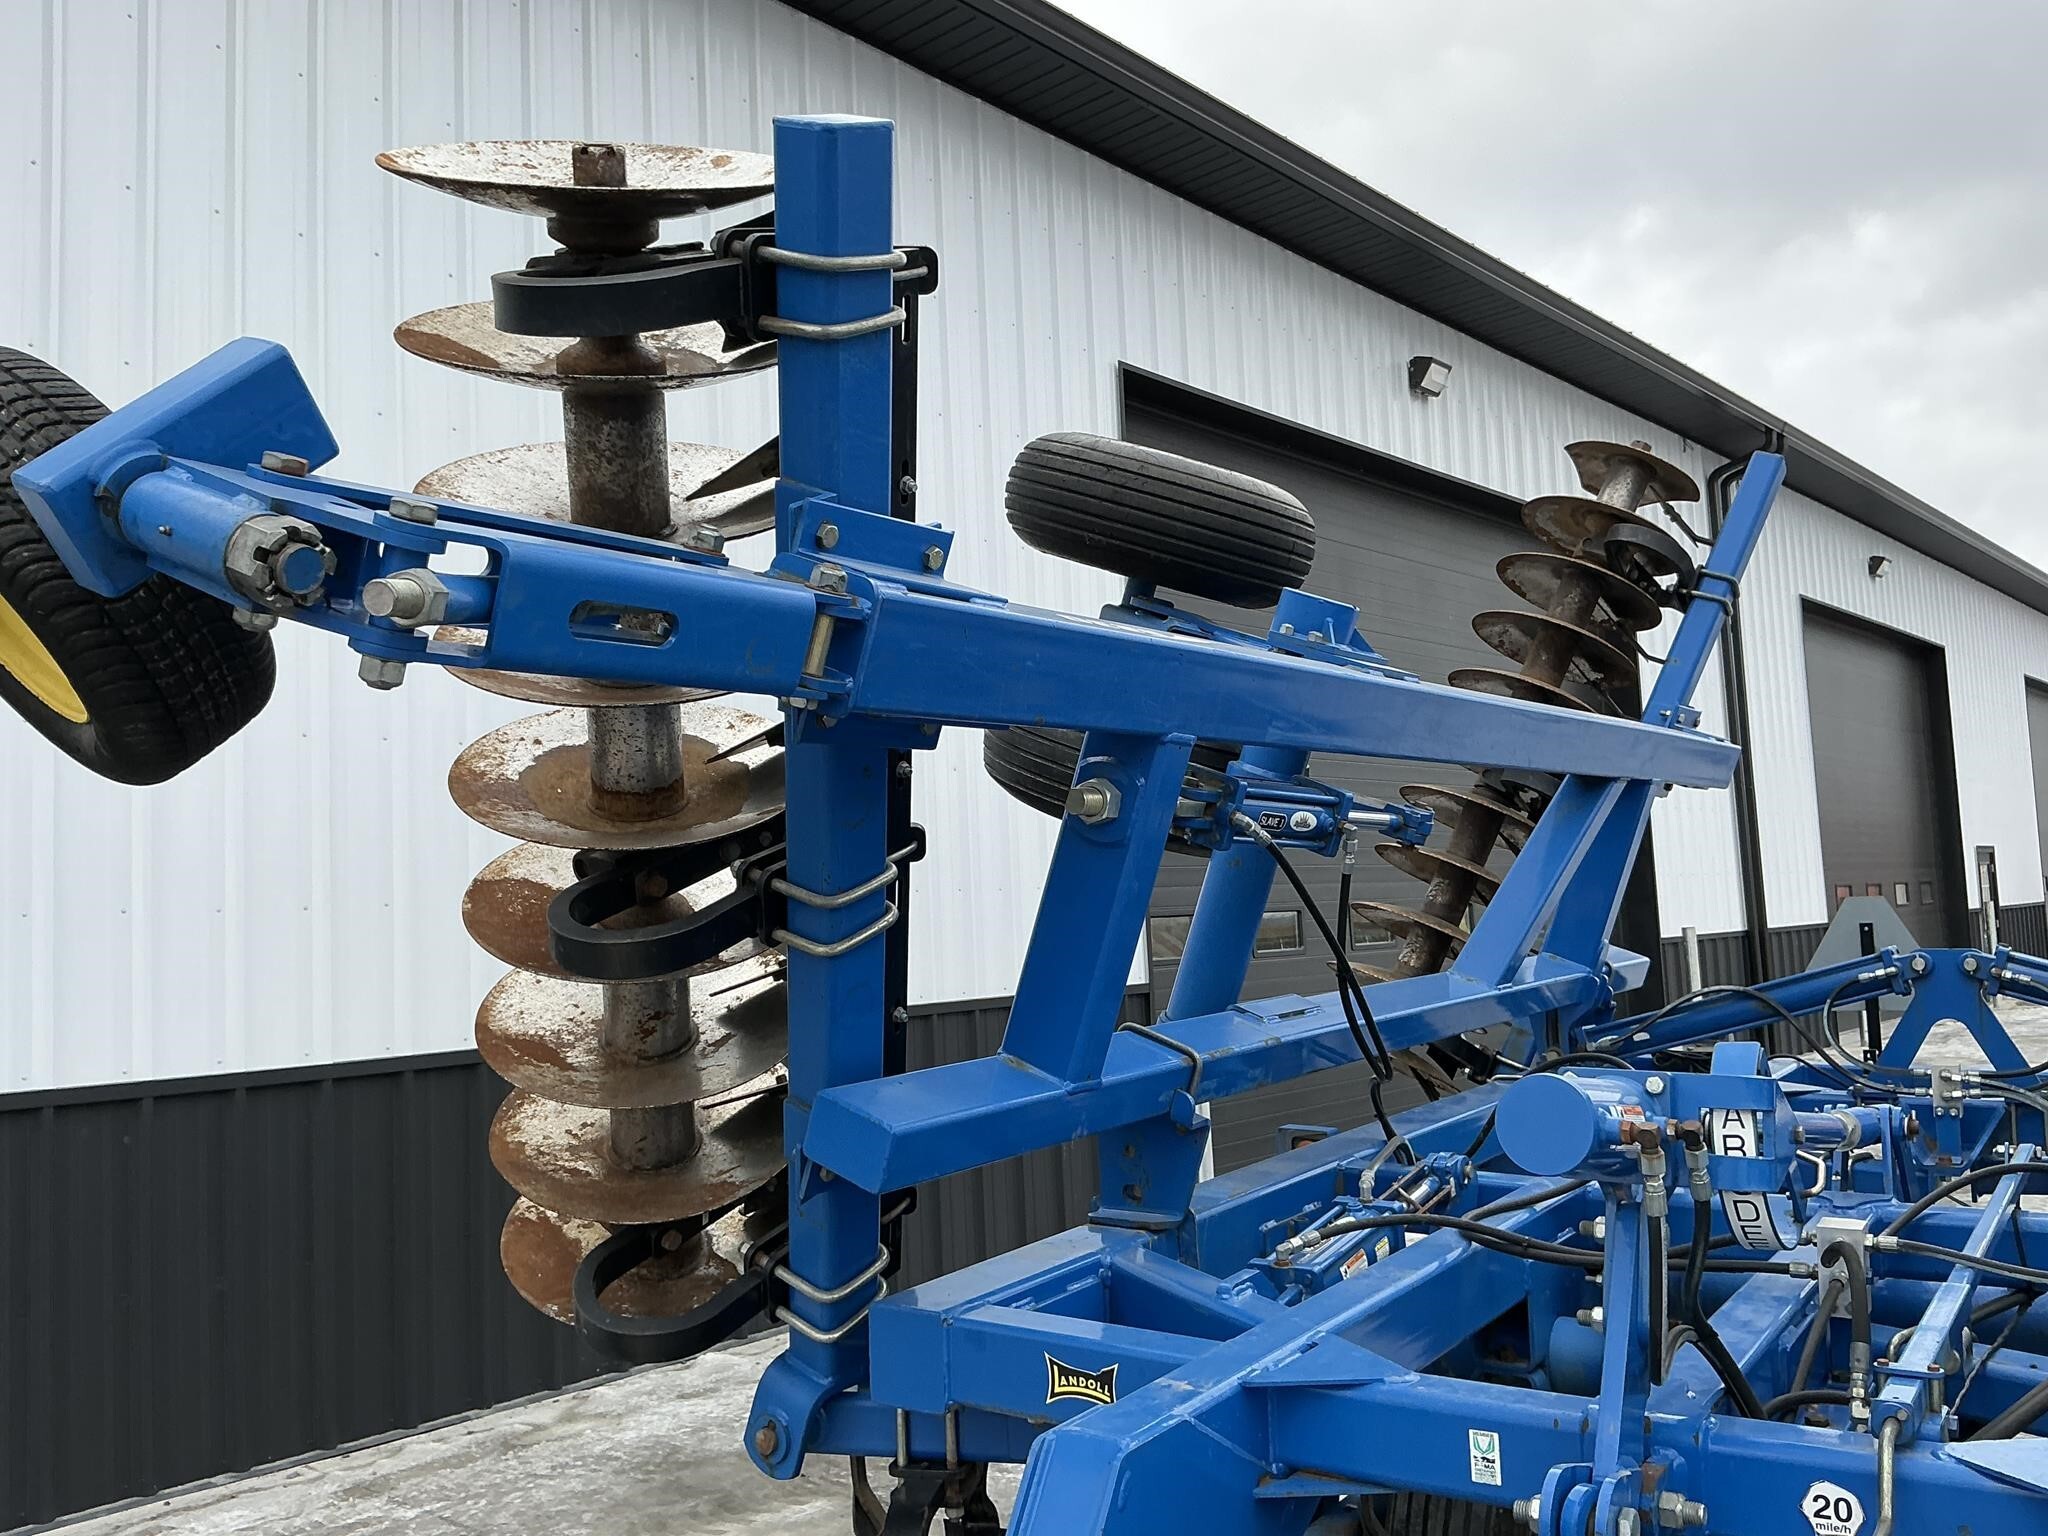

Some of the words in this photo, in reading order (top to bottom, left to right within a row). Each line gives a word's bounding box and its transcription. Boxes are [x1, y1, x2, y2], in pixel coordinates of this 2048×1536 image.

[1260, 816, 1280, 828] SLAVE
[1733, 1199, 1761, 1222] D
[1053, 1364, 1111, 1403] LANDOLL
[1812, 1494, 1853, 1523] 20
[1815, 1522, 1852, 1535] mile/h
